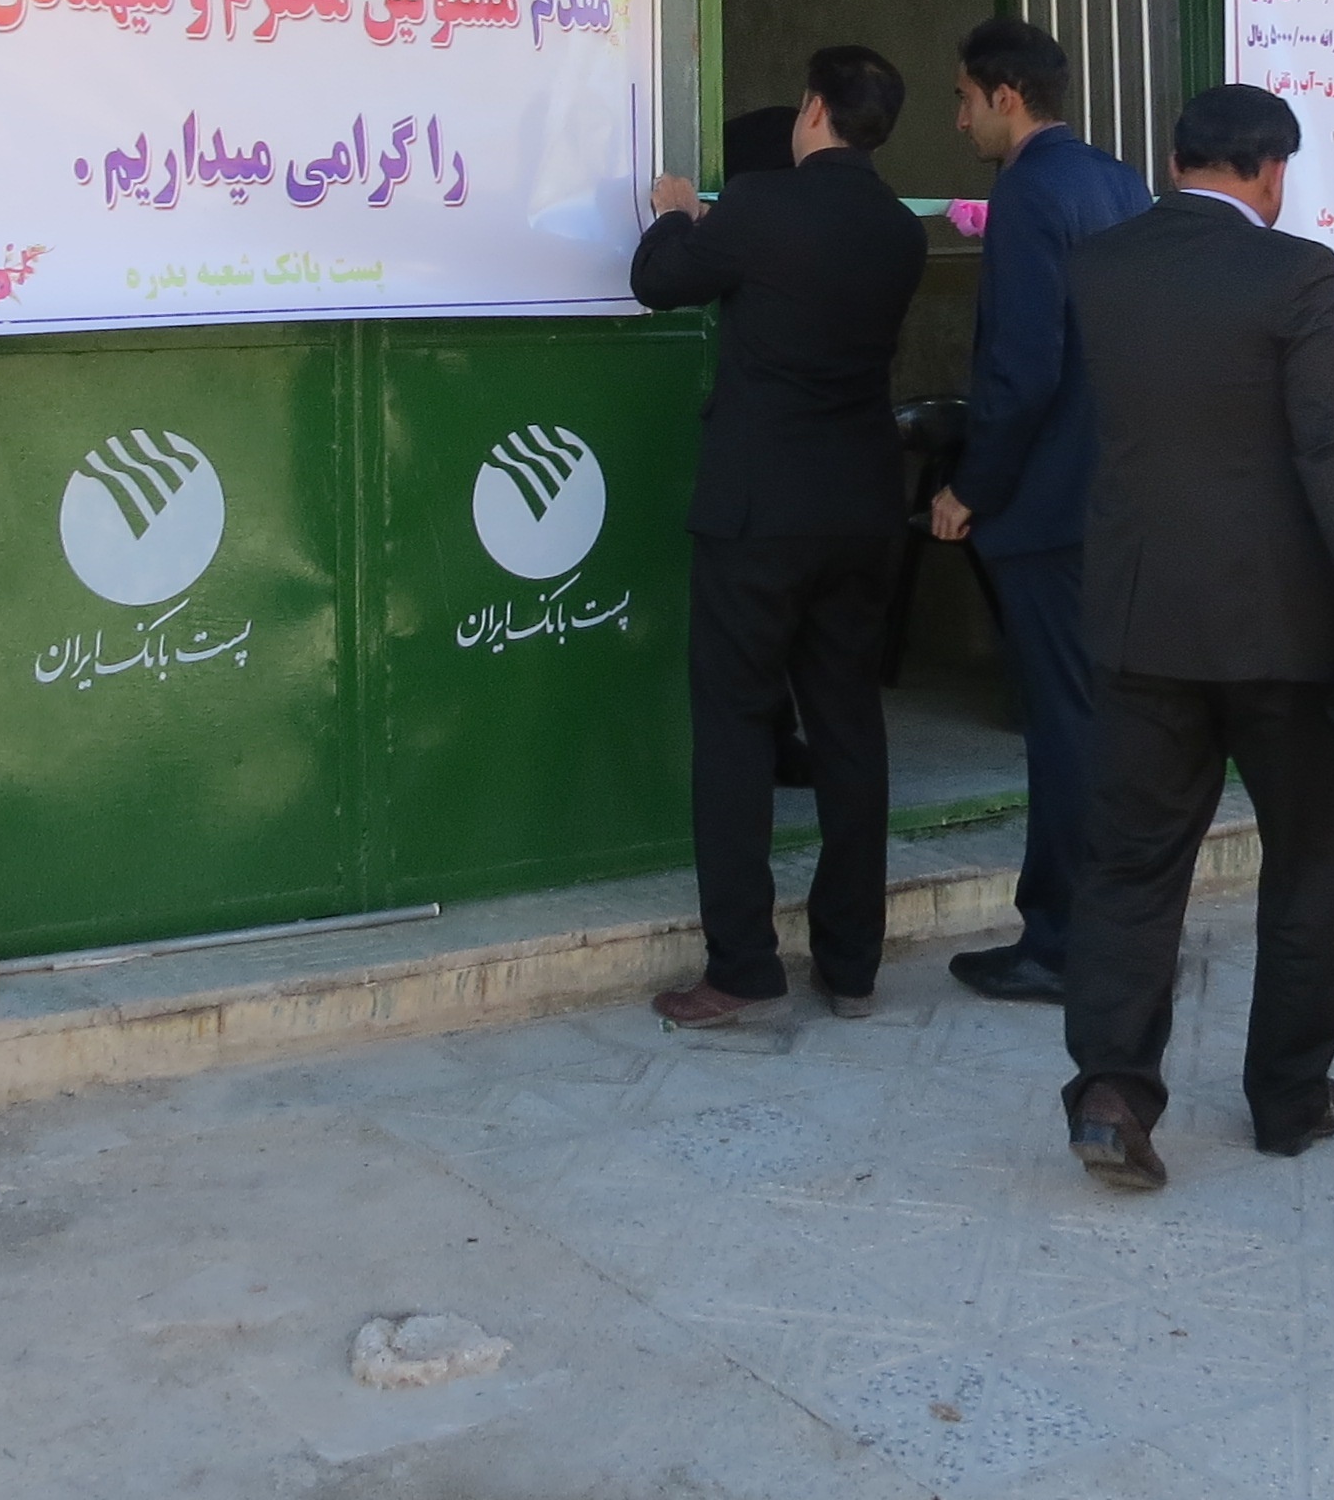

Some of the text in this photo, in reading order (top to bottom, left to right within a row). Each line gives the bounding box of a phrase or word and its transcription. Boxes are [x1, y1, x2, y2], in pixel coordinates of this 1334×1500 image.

[1247, 25, 1269, 48] ریال
[285, 111, 414, 209] گرامی
[425, 114, 469, 209] را
[197, 254, 254, 296] شعبه
[264, 252, 321, 291] بانک
[328, 258, 385, 293] پست
[456, 573, 630, 653] پست بانک ایران
[34, 599, 252, 690] پست بانک ایران
